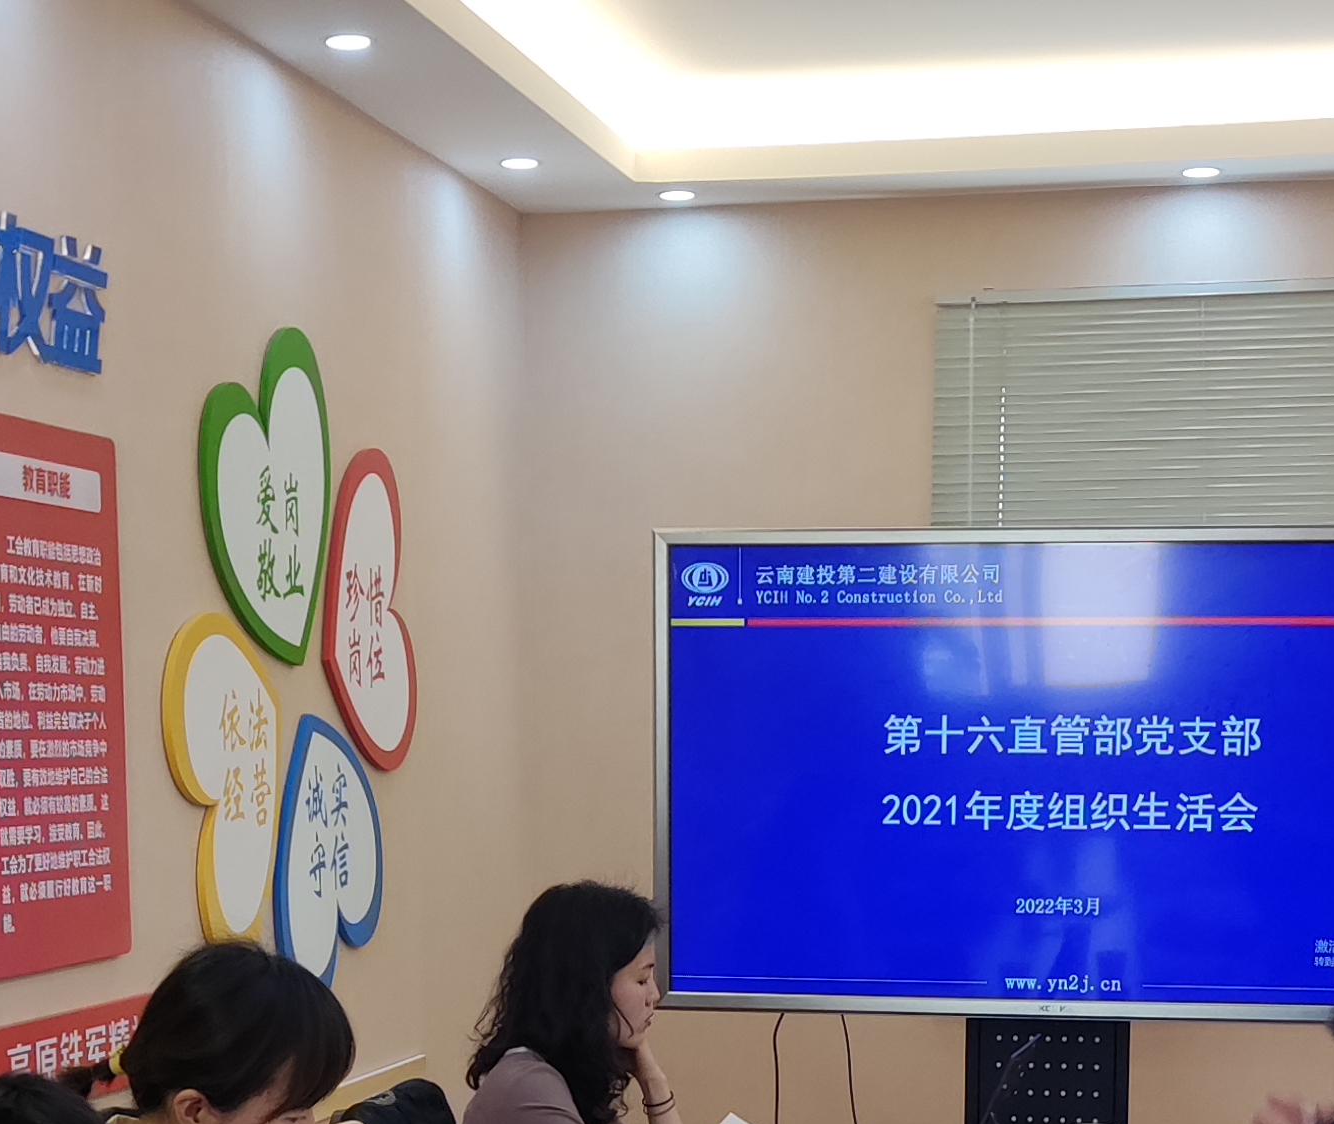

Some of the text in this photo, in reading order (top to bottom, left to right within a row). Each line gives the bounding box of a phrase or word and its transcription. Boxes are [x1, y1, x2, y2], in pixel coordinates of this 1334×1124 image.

[23, 464, 71, 500] 教育职能
[256, 465, 300, 537] 爱岗
[257, 537, 306, 602] 敬业
[344, 564, 386, 628] 珍惜
[755, 563, 1001, 587] 云南建投第二建设有限公司
[755, 589, 1004, 607] YCIH No.2 Construction Co.,Ltd
[687, 595, 722, 607] YCIH
[346, 629, 386, 688] 岗位
[219, 687, 269, 754] 依法
[883, 714, 1263, 757] 第十六直管部党支部
[222, 758, 272, 828] 经营
[303, 763, 349, 829] 诚实
[882, 790, 1259, 833] 2021年度组织生活会
[308, 830, 350, 901] 守信
[1015, 897, 1101, 916] 2022年3月
[1005, 975, 1121, 993] www.yn2j.cn
[7, 1015, 139, 1080] 高原铁军精
